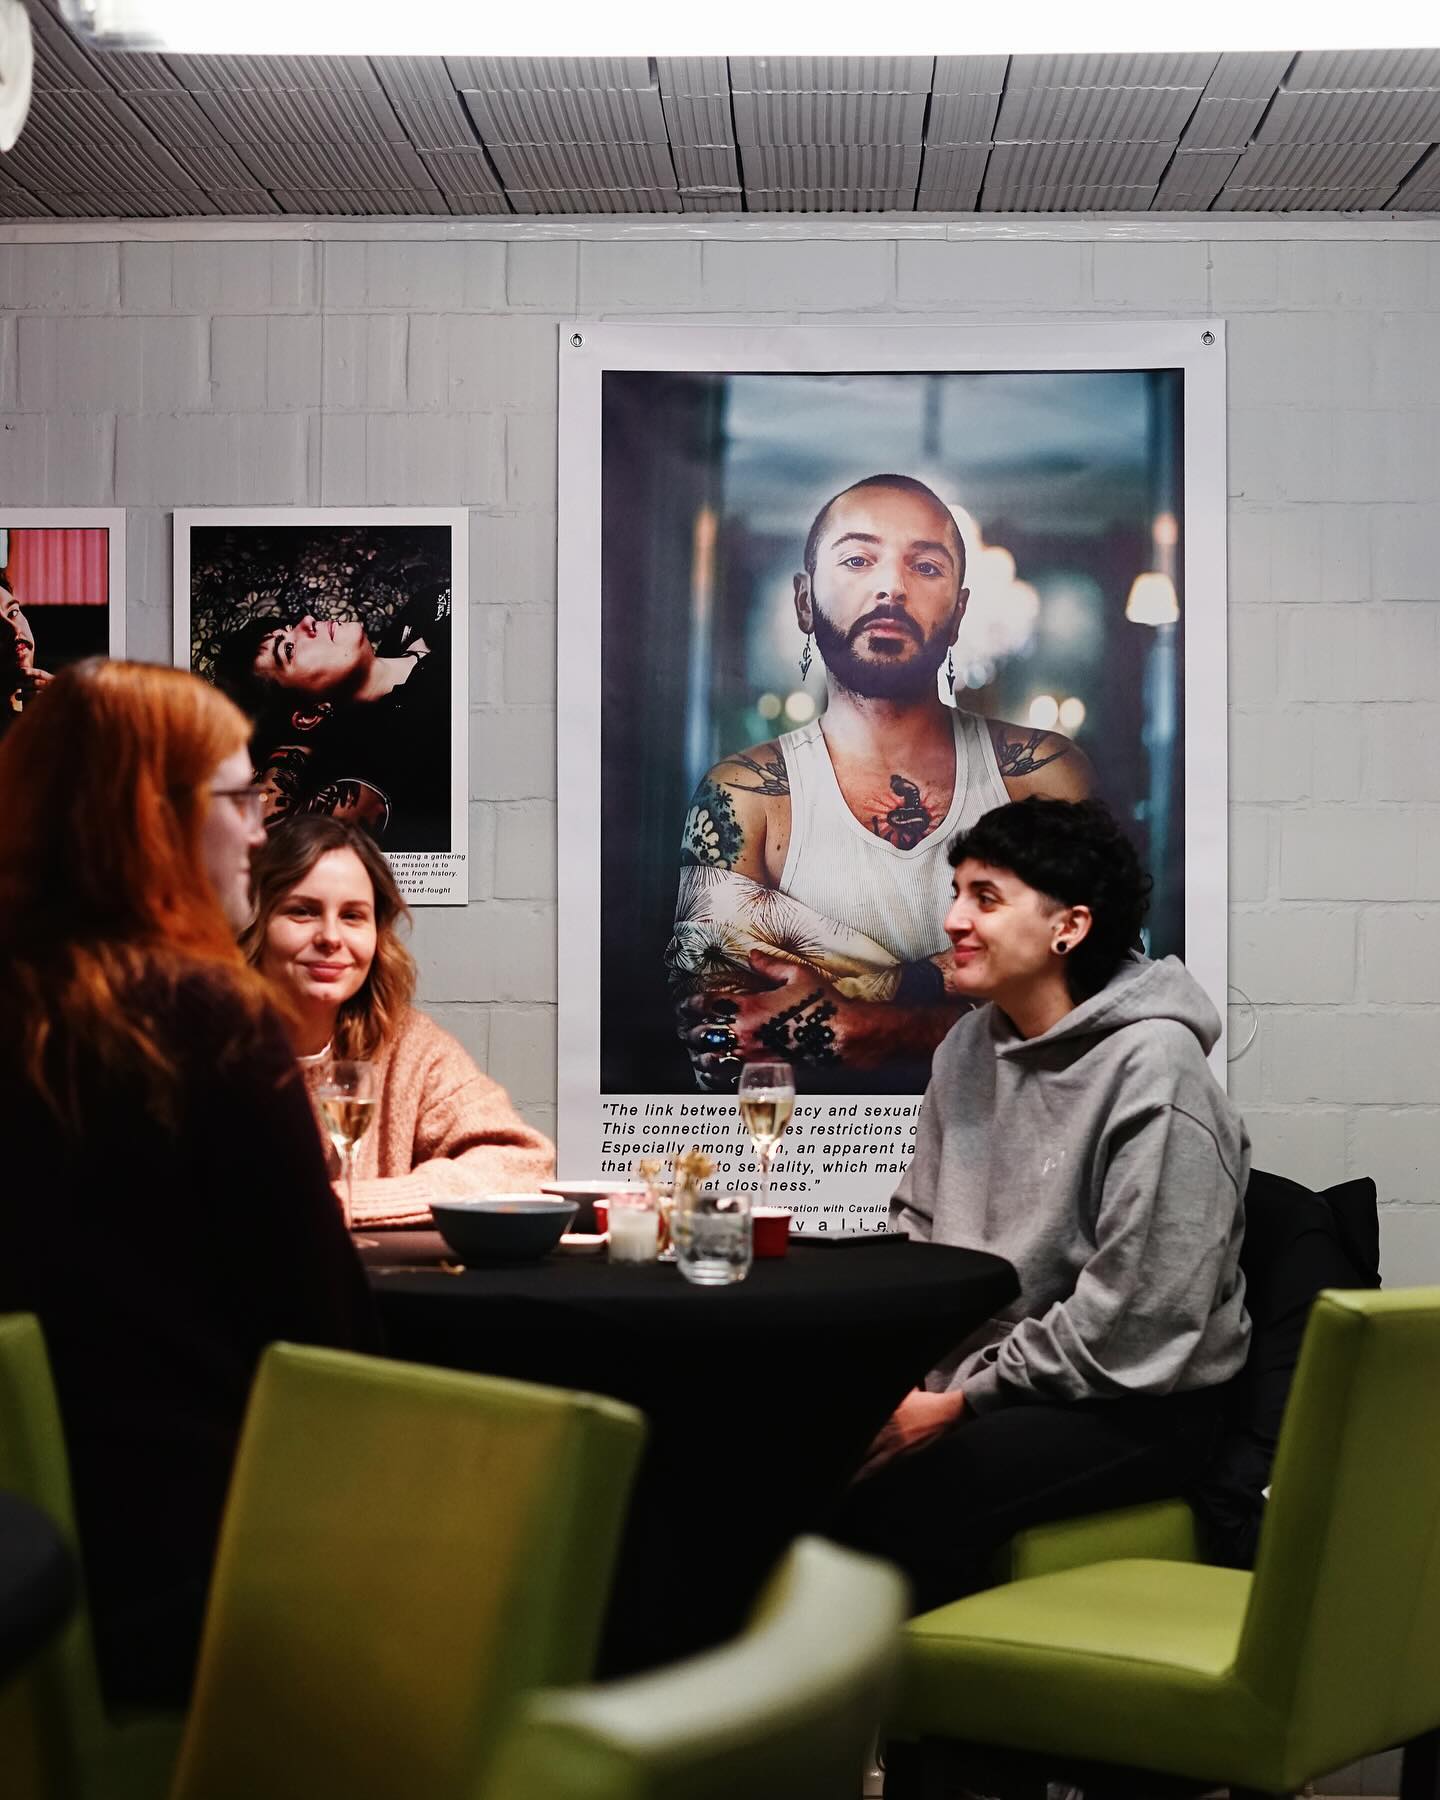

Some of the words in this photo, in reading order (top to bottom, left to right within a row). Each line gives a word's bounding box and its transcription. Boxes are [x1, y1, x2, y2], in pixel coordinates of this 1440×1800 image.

[430, 870, 458, 878] history.
[602, 1103, 638, 1116] "The
[645, 1103, 673, 1116] link
[828, 1104, 858, 1117] and
[864, 1104, 922, 1117] sexuali
[602, 1122, 636, 1135] This
[643, 1122, 730, 1135] connection
[810, 1123, 902, 1136] restrictions
[601, 1141, 685, 1156] Especially
[692, 1143, 744, 1156] among
[796, 1145, 816, 1154] an
[822, 1143, 894, 1156] apparent
[601, 1160, 633, 1172] that
[716, 1161, 731, 1172] to
[738, 1160, 815, 1175] seality,
[822, 1160, 868, 1173] which
[874, 1160, 907, 1173] mak
[823, 1204, 844, 1213] with
[848, 1204, 890, 1213] Cavalie
